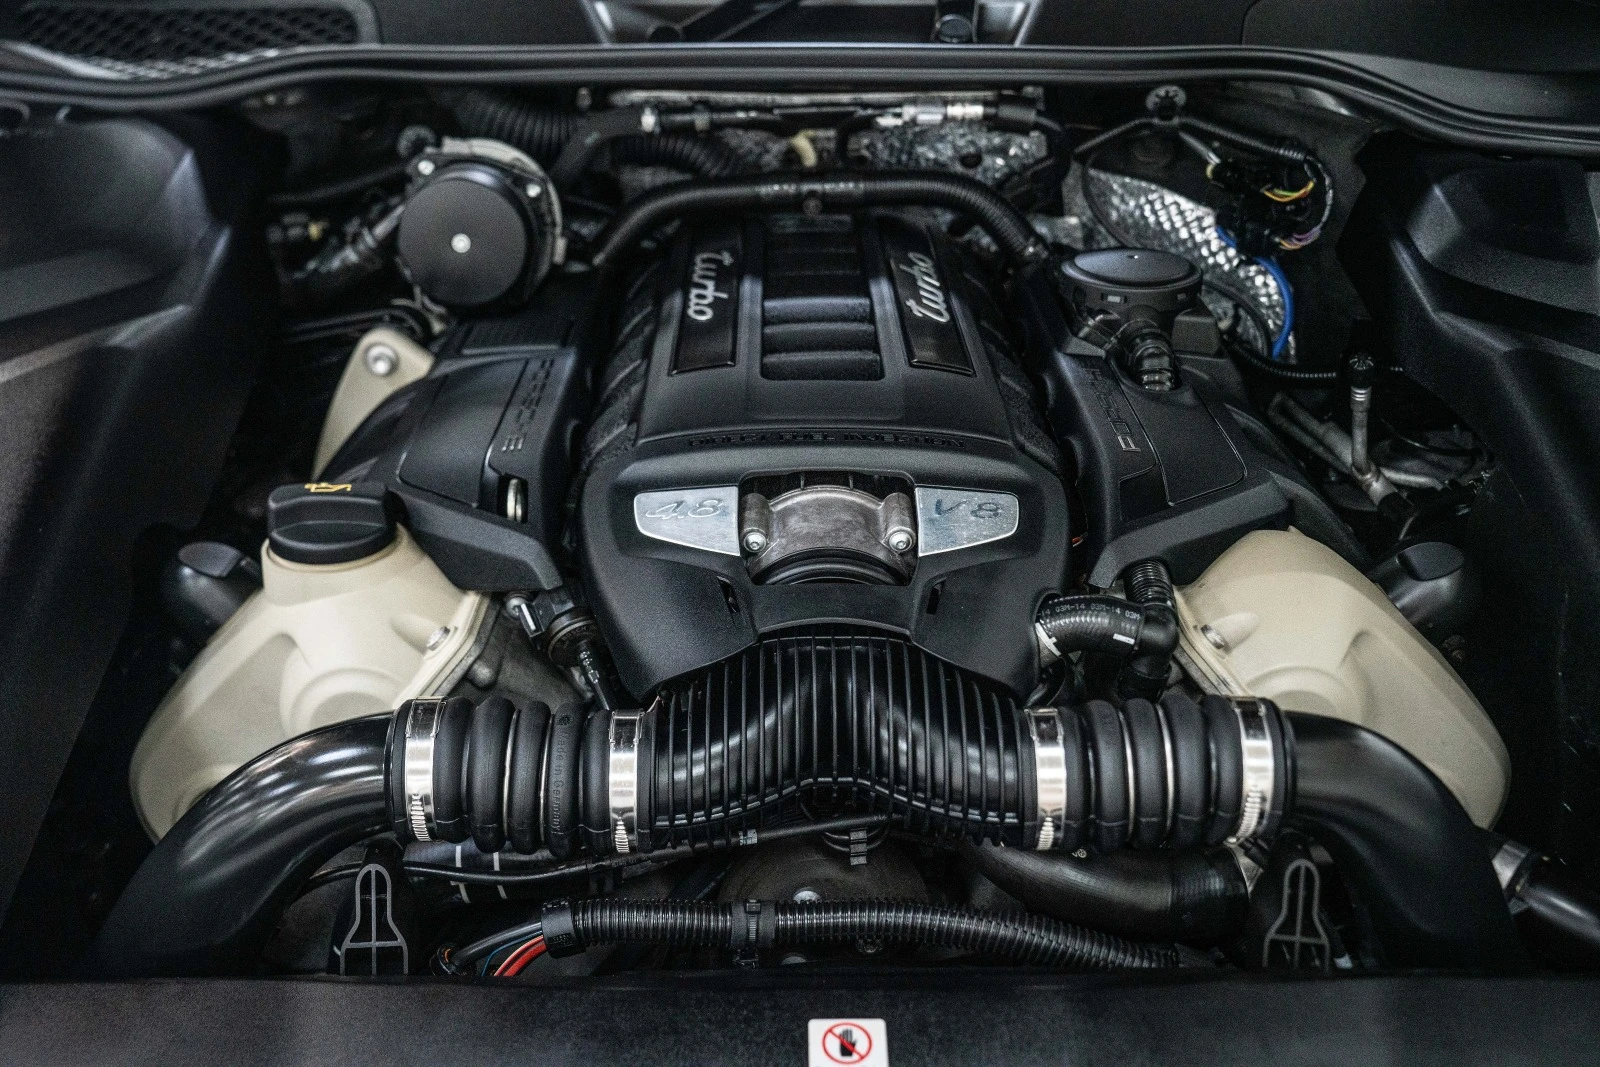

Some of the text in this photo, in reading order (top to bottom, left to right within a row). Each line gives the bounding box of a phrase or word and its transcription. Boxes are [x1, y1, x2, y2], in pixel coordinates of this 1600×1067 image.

[687, 250, 734, 321] turbo
[900, 251, 950, 323] turbo
[645, 500, 723, 520] 4.8
[555, 730, 569, 762] Made
